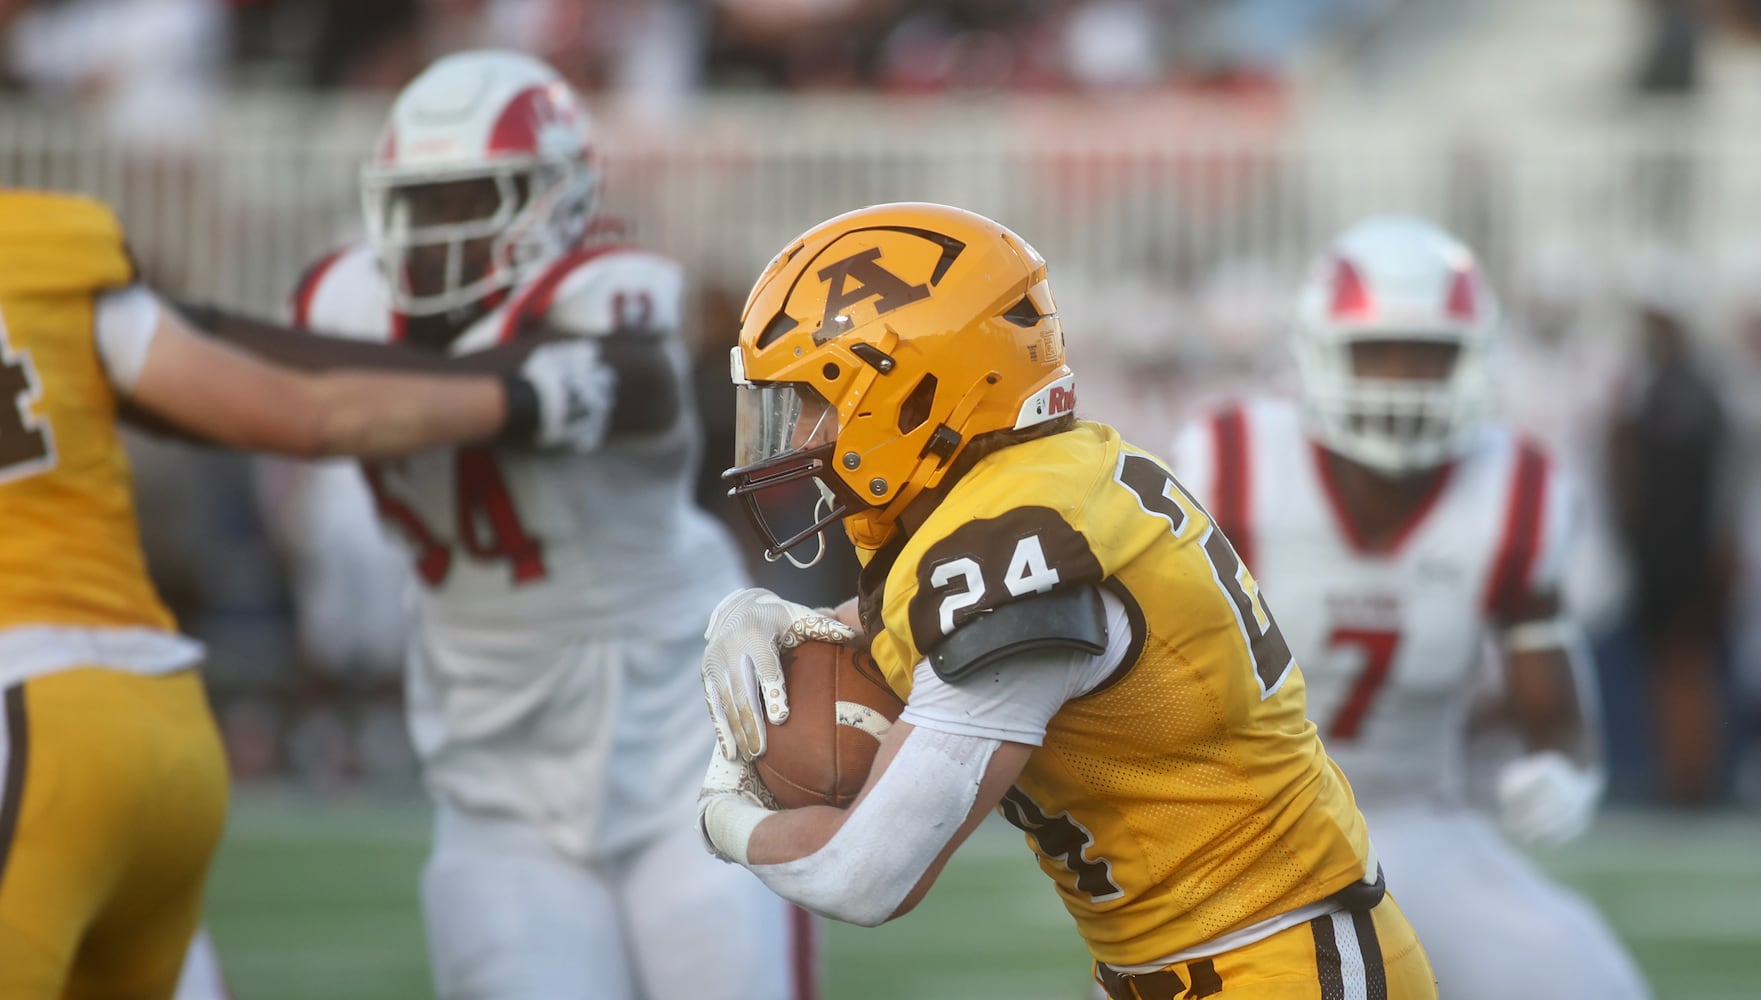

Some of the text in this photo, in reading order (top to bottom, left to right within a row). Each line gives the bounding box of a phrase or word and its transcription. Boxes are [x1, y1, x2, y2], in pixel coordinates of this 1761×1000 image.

[812, 247, 932, 347] A
[930, 534, 1060, 635] 24
[1328, 628, 1401, 741] 7
